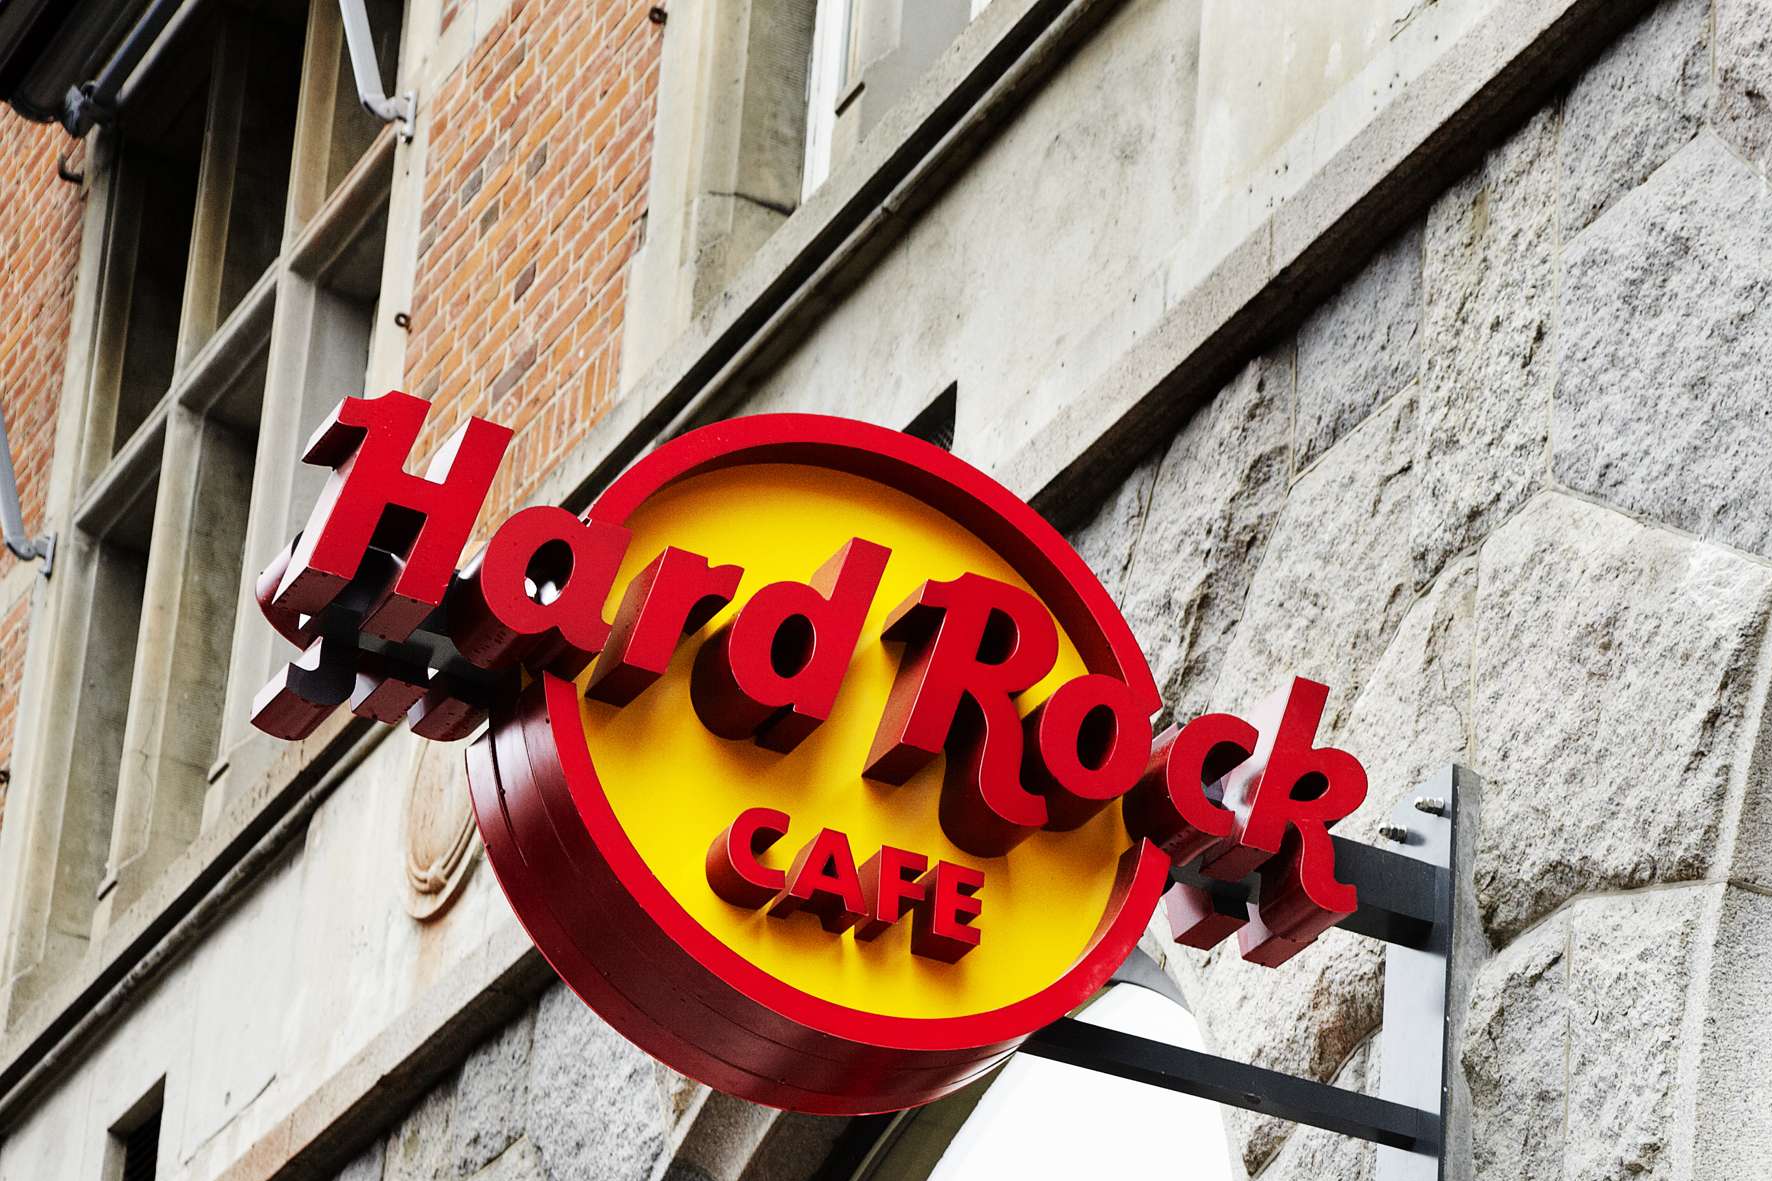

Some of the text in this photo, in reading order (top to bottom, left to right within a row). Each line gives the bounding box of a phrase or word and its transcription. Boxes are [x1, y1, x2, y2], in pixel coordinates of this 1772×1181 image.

[302, 390, 1370, 916] Hard Rock
[728, 806, 985, 945] CAFE
